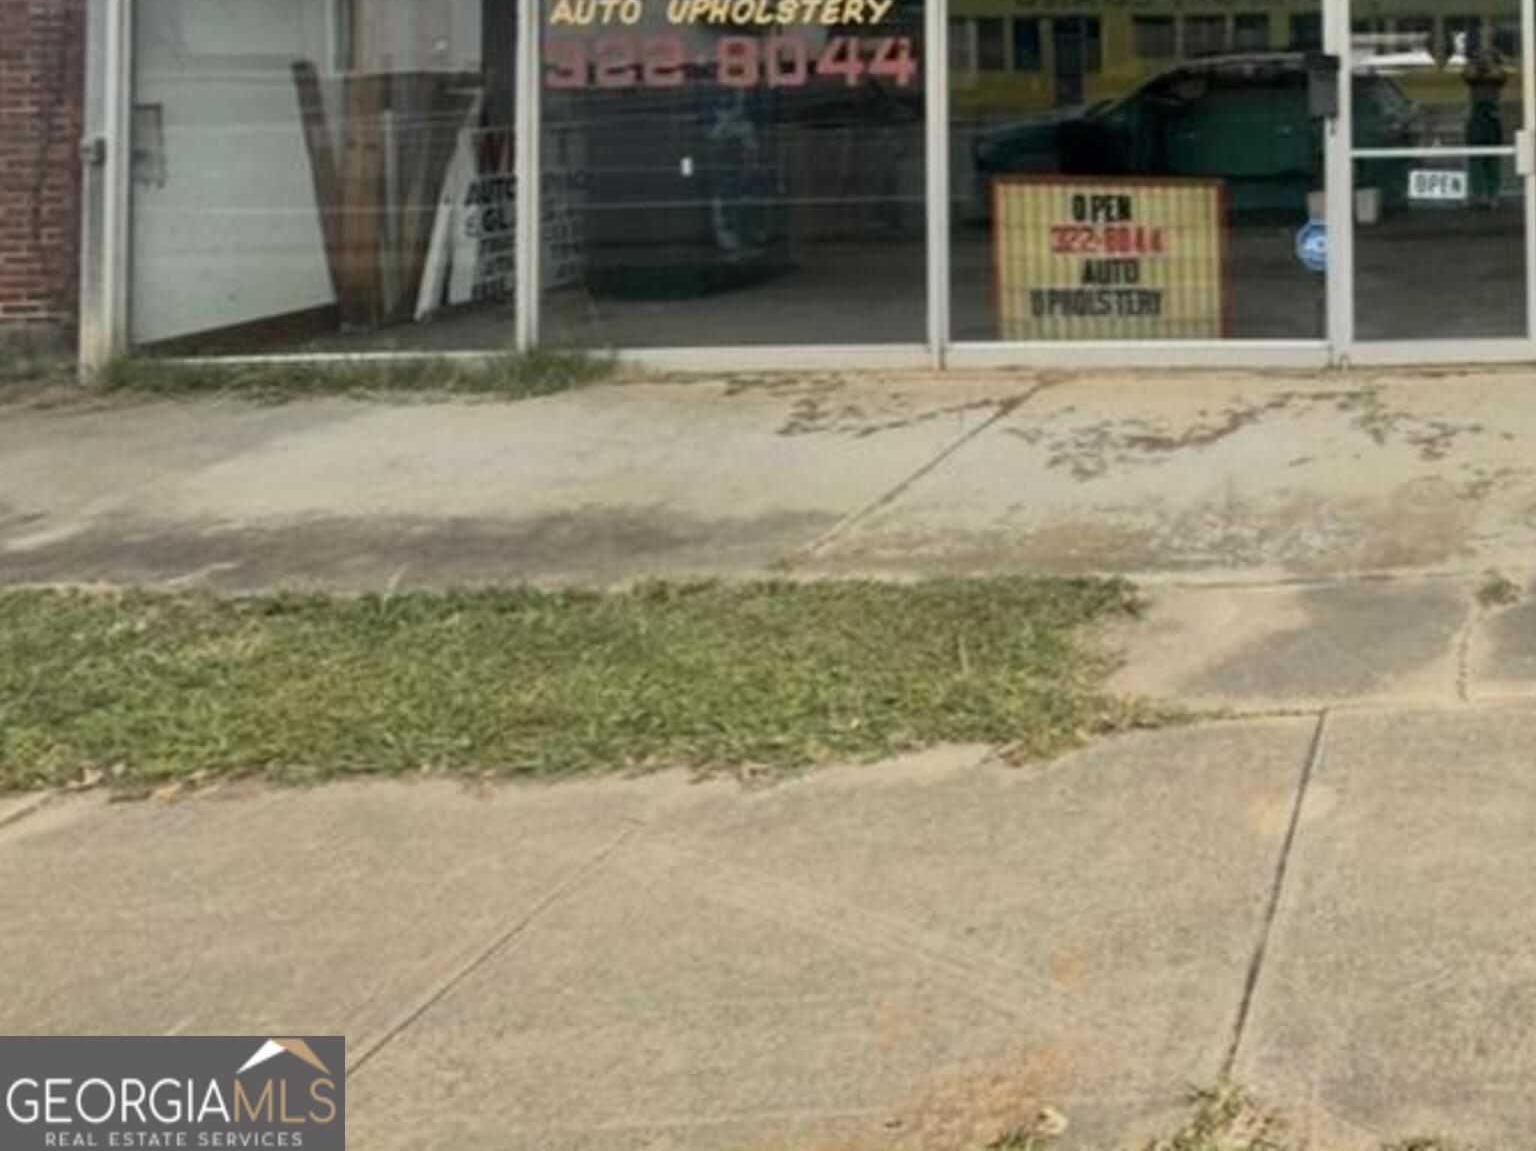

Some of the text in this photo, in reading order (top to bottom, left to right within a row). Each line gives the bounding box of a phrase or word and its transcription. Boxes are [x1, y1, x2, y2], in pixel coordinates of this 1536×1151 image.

[1413, 176, 1463, 195] OPEN
[1072, 194, 1132, 221] OPEN
[1082, 258, 1141, 285] AUTO
